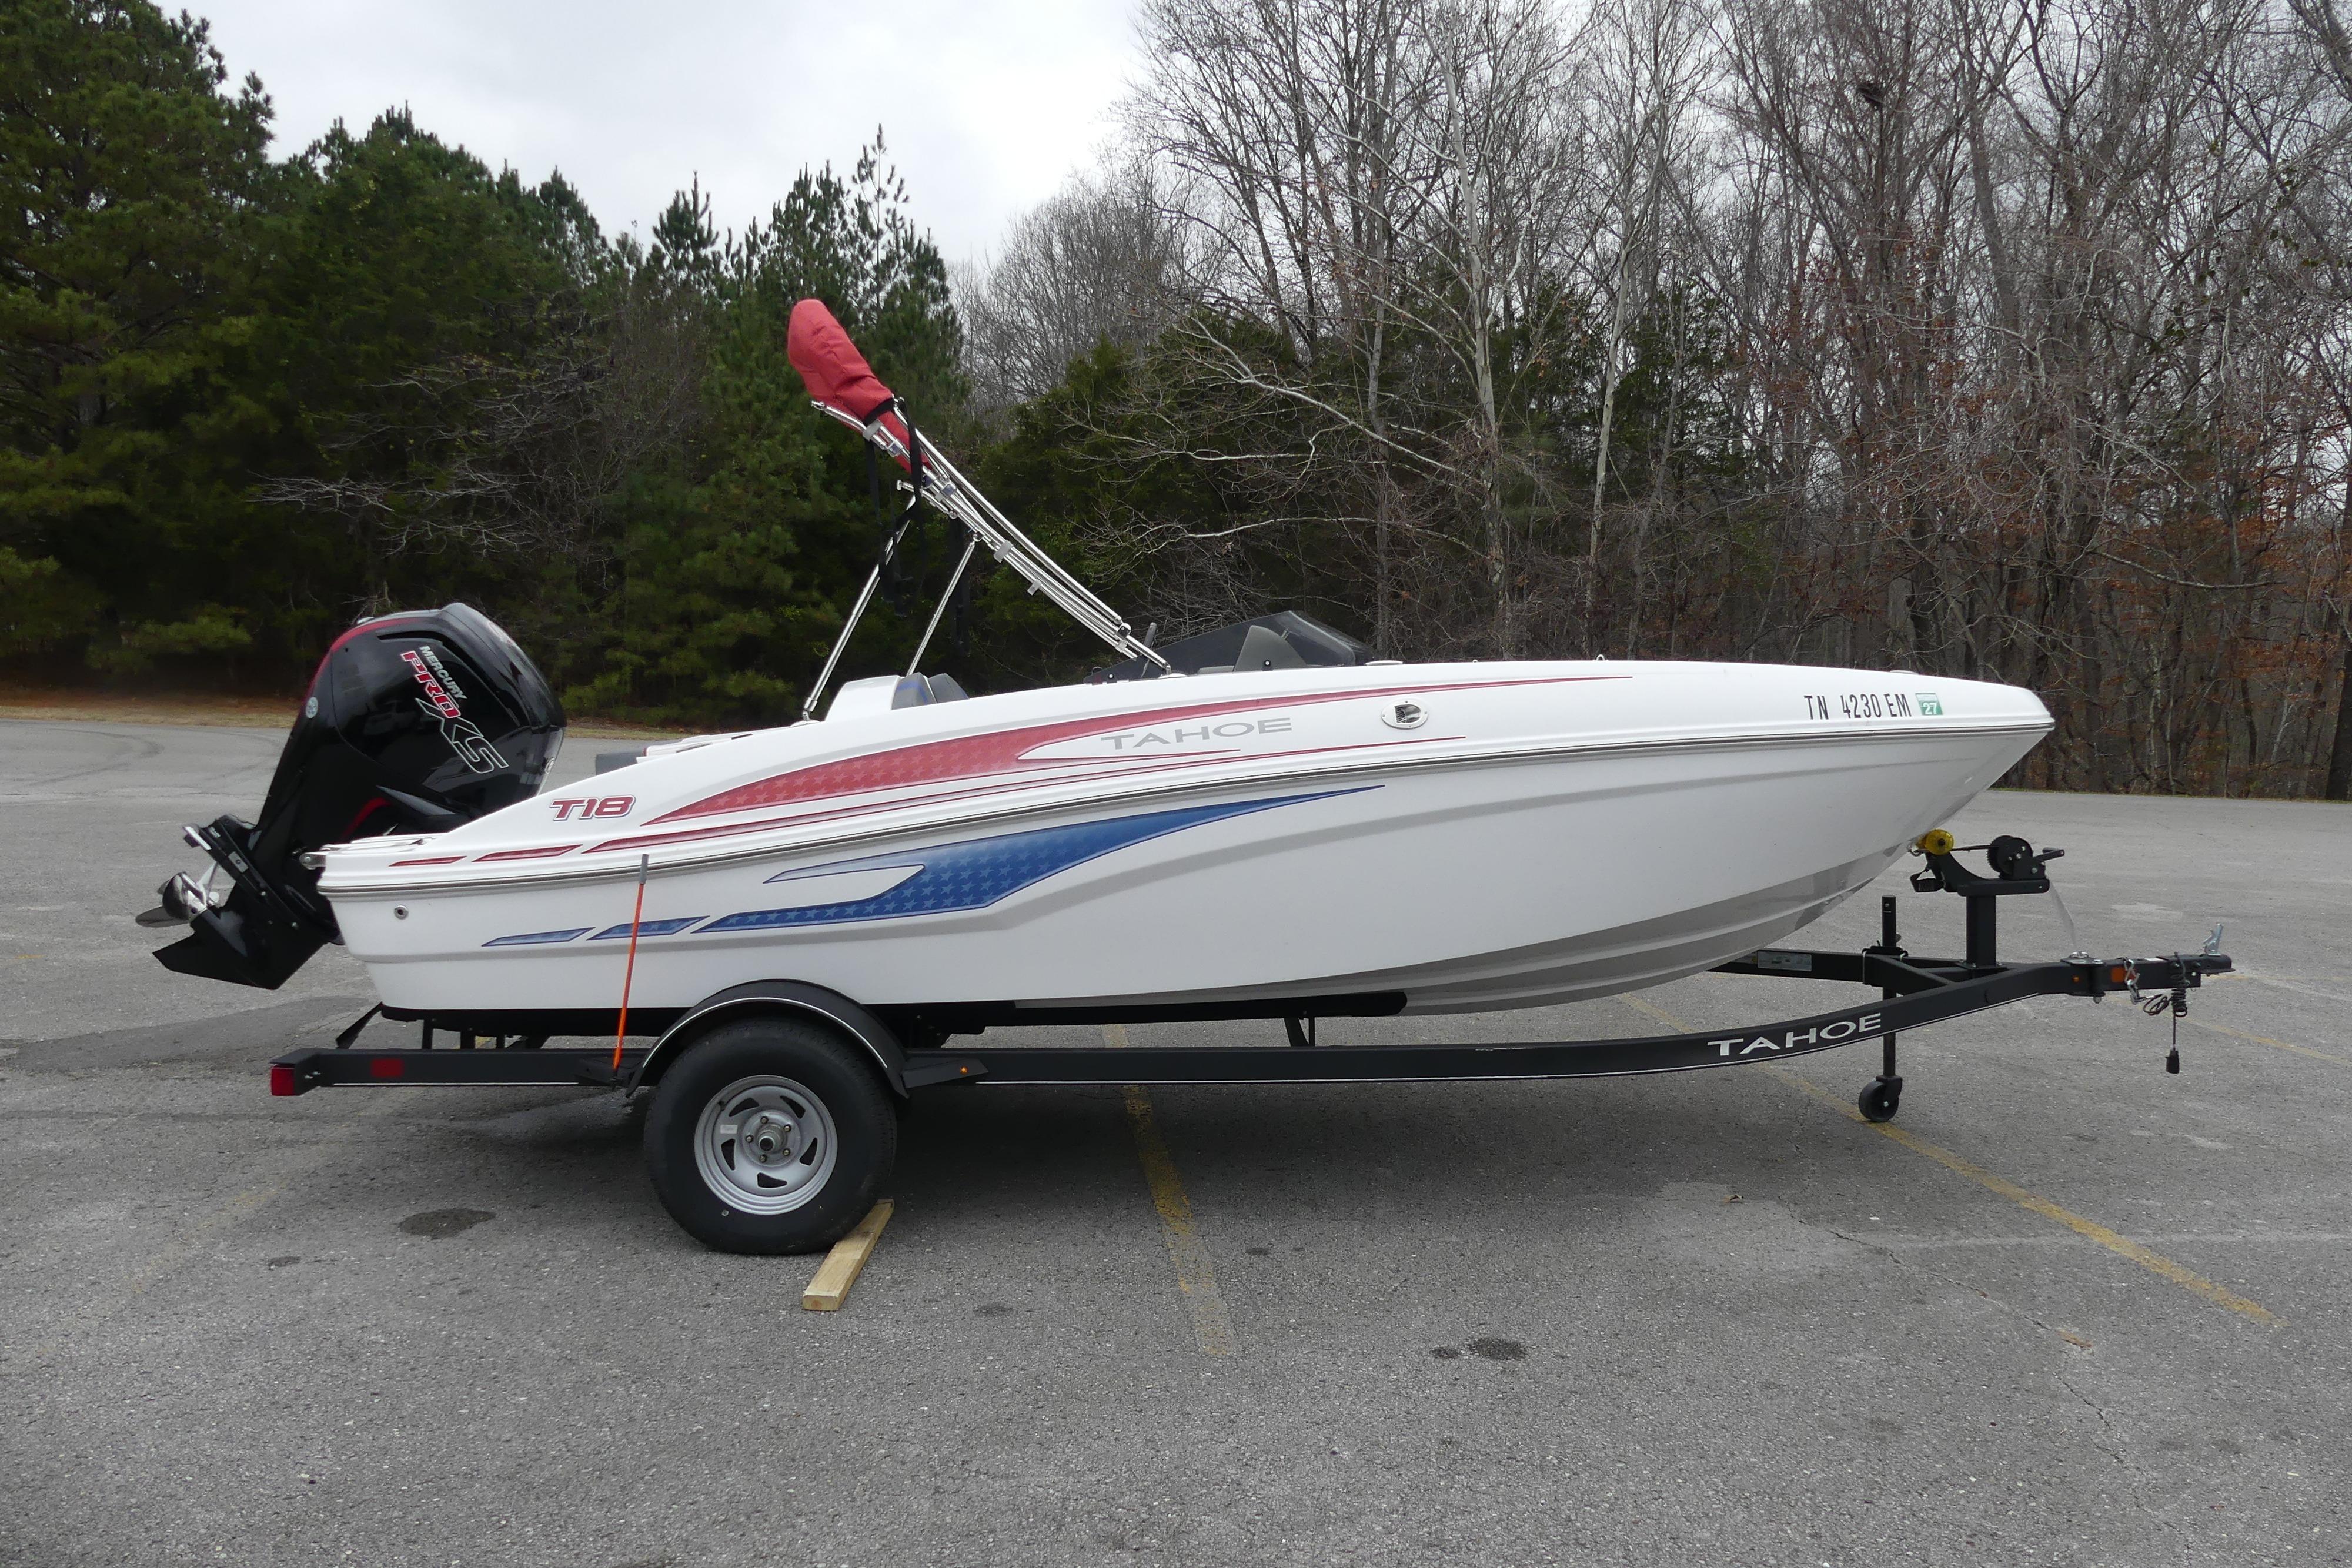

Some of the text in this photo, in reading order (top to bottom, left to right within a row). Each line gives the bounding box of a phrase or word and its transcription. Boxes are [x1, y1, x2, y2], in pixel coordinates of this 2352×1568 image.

[419, 646, 468, 700] MERCURY
[400, 650, 510, 774] PRO XS
[1803, 693, 1912, 720] TN 4230 EM
[1922, 702, 1937, 715] 27
[1100, 717, 1292, 750] TAHOE
[549, 795, 636, 821] T18
[1707, 1012, 1881, 1056] TAHOE
